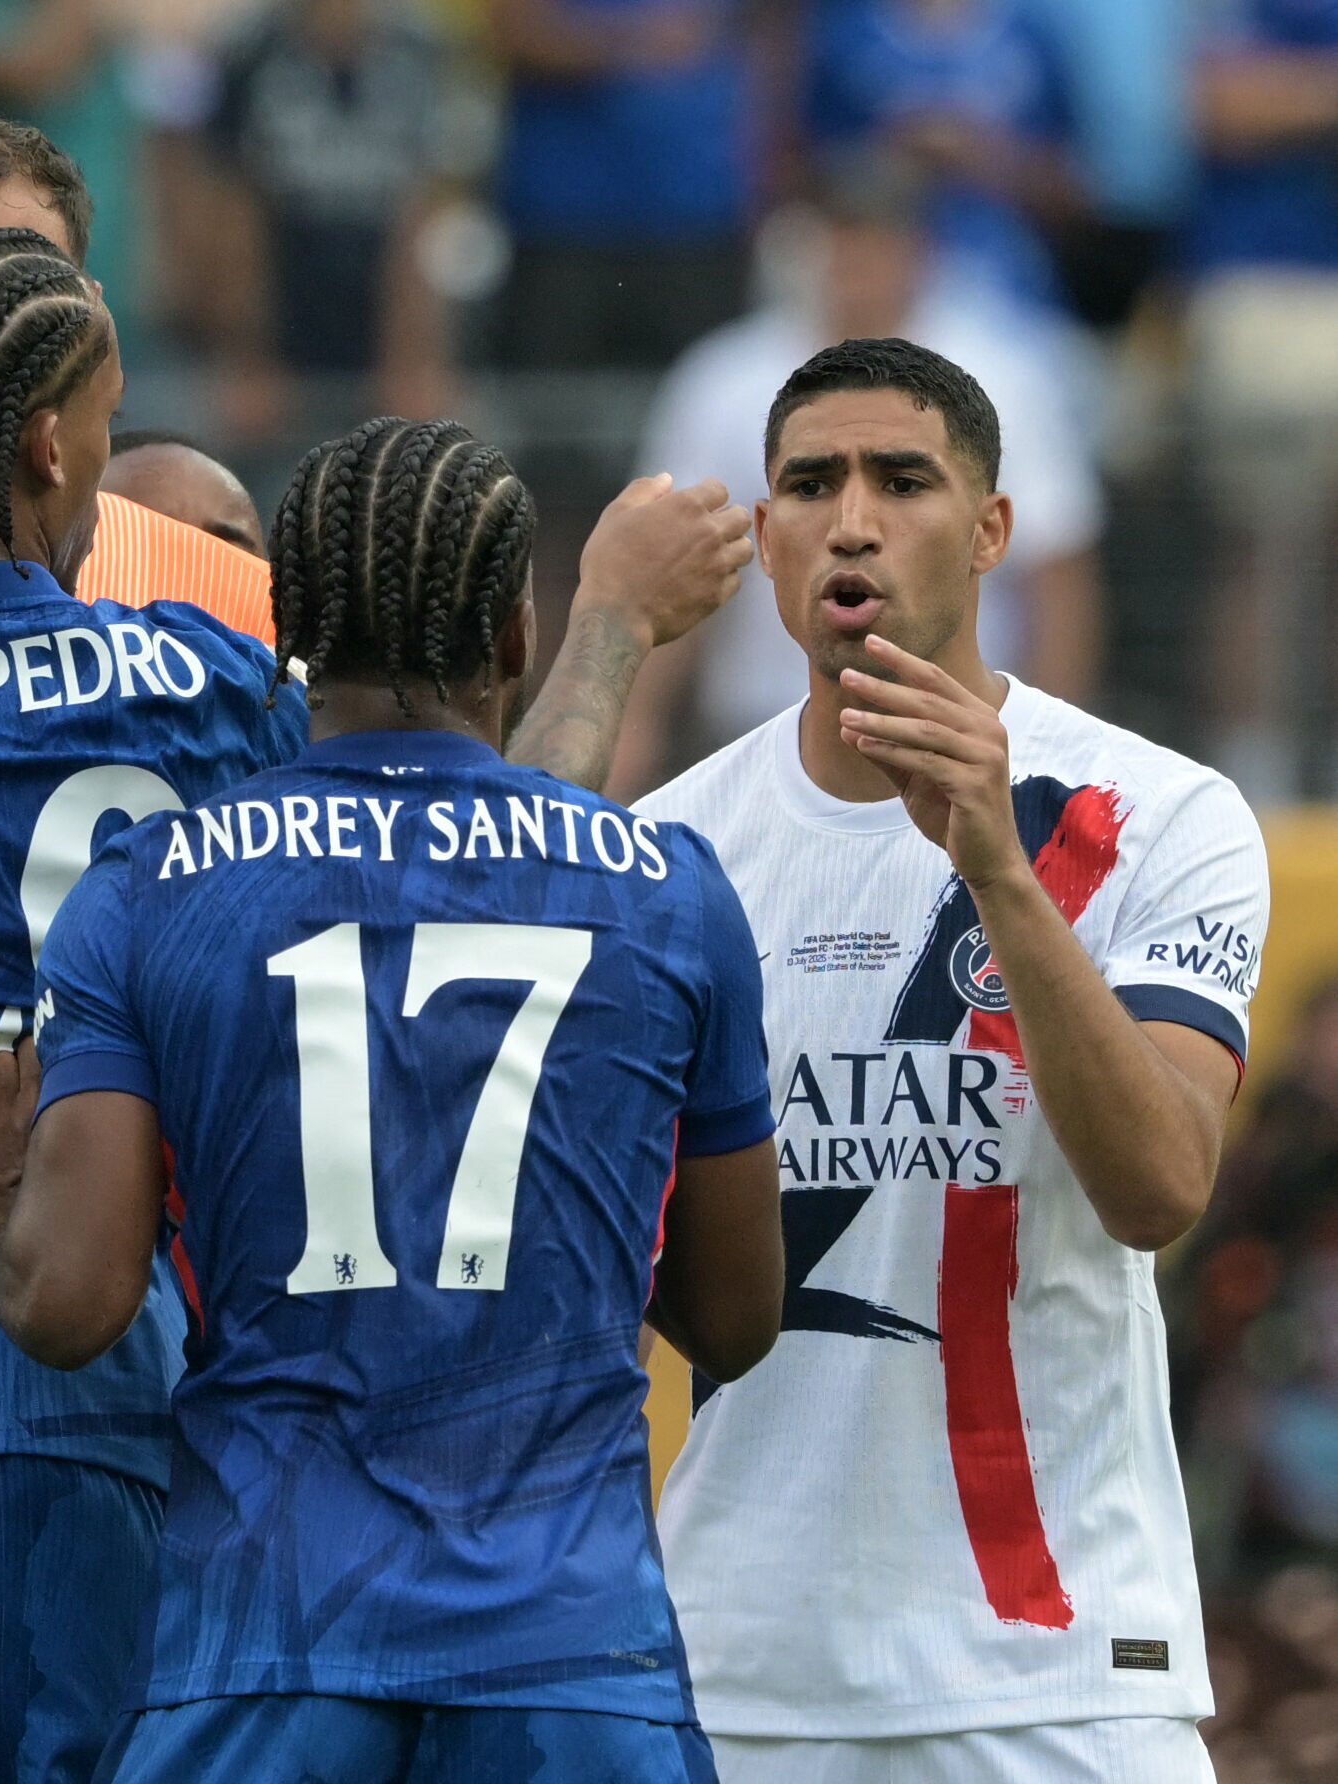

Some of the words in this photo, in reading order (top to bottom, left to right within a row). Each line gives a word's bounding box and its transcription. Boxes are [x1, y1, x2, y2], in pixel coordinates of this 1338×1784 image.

[158, 796, 404, 880] ANDREY
[428, 795, 668, 880] SANTOS
[266, 922, 593, 1295] 17
[777, 1050, 1002, 1129] ATAR
[779, 1136, 1002, 1184] AIRWAYS
